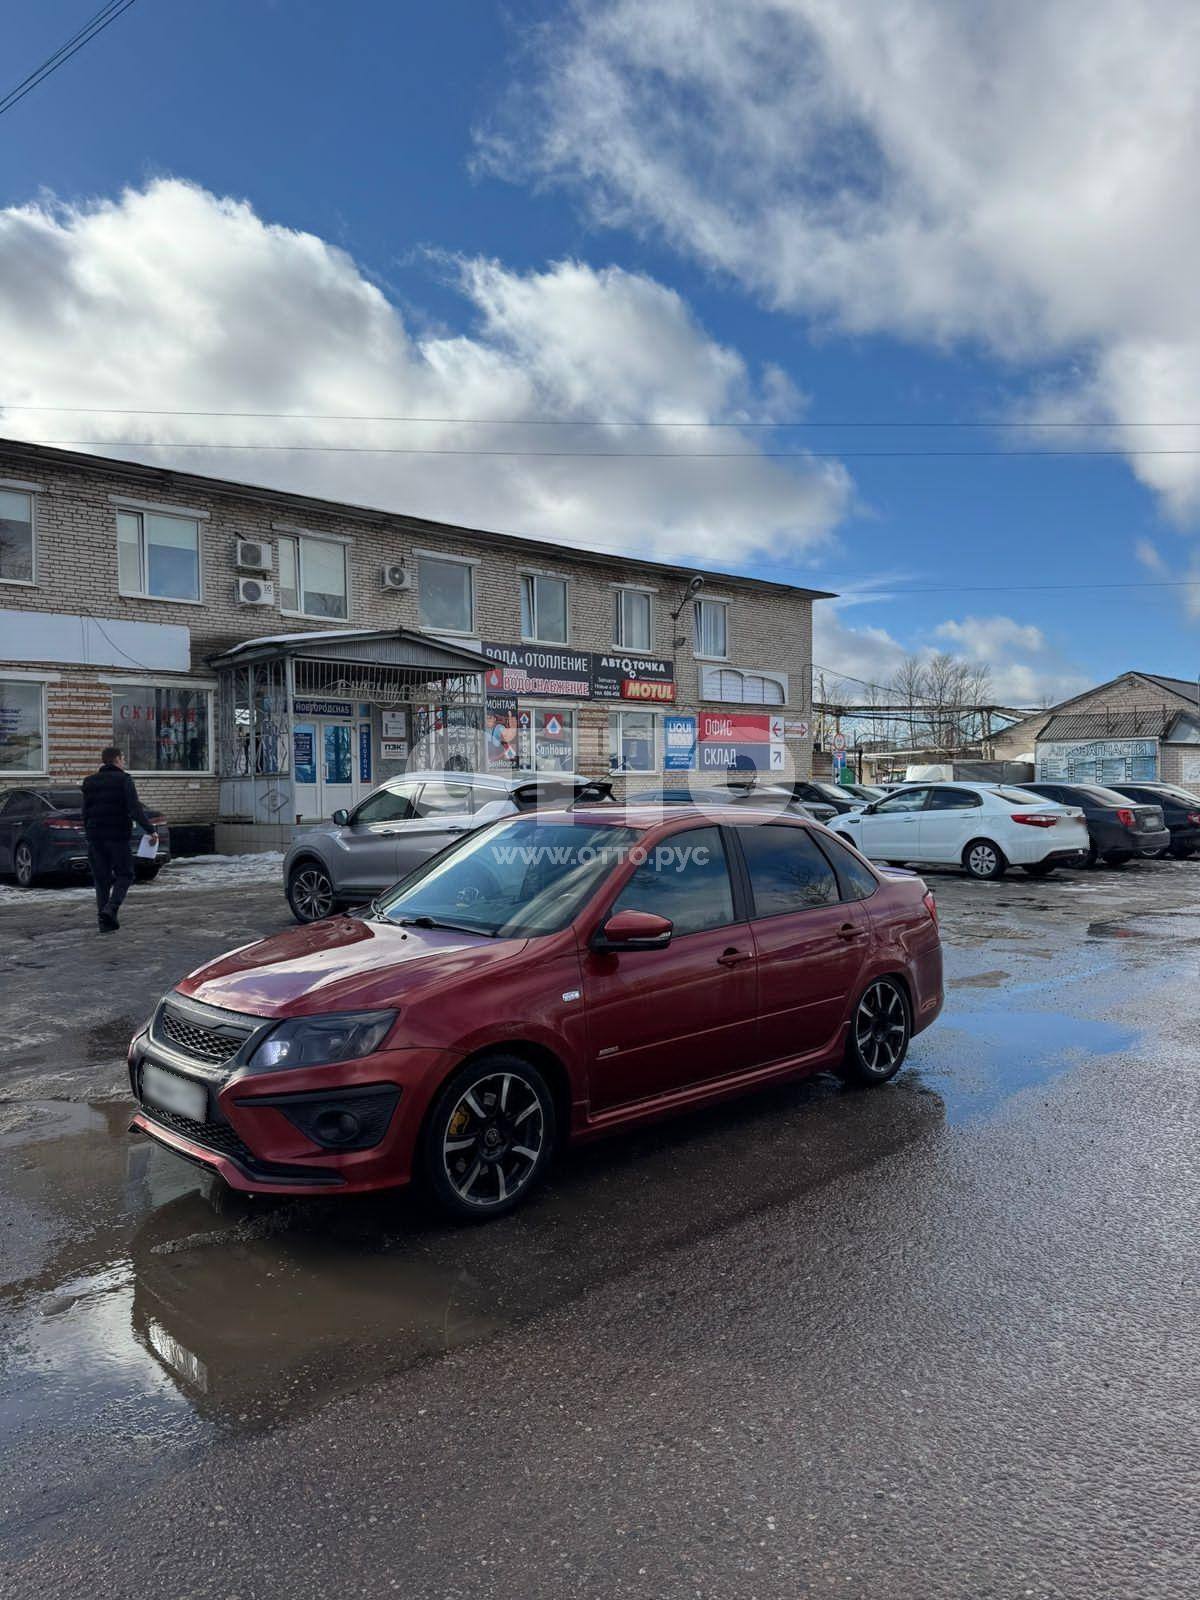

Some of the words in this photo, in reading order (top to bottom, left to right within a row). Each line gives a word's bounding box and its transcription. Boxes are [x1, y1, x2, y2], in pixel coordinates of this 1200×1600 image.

[525, 653, 588, 672] ОТОПЛЕНИЕ
[503, 677, 590, 696] ВОДОСНАБЖЕНИЕ
[627, 682, 673, 699] MOTUL
[487, 699, 516, 709] МОНТАЖ
[669, 722, 692, 733] LIQUI
[705, 719, 733, 736] ОФИС
[704, 748, 737, 767] СКЛАД
